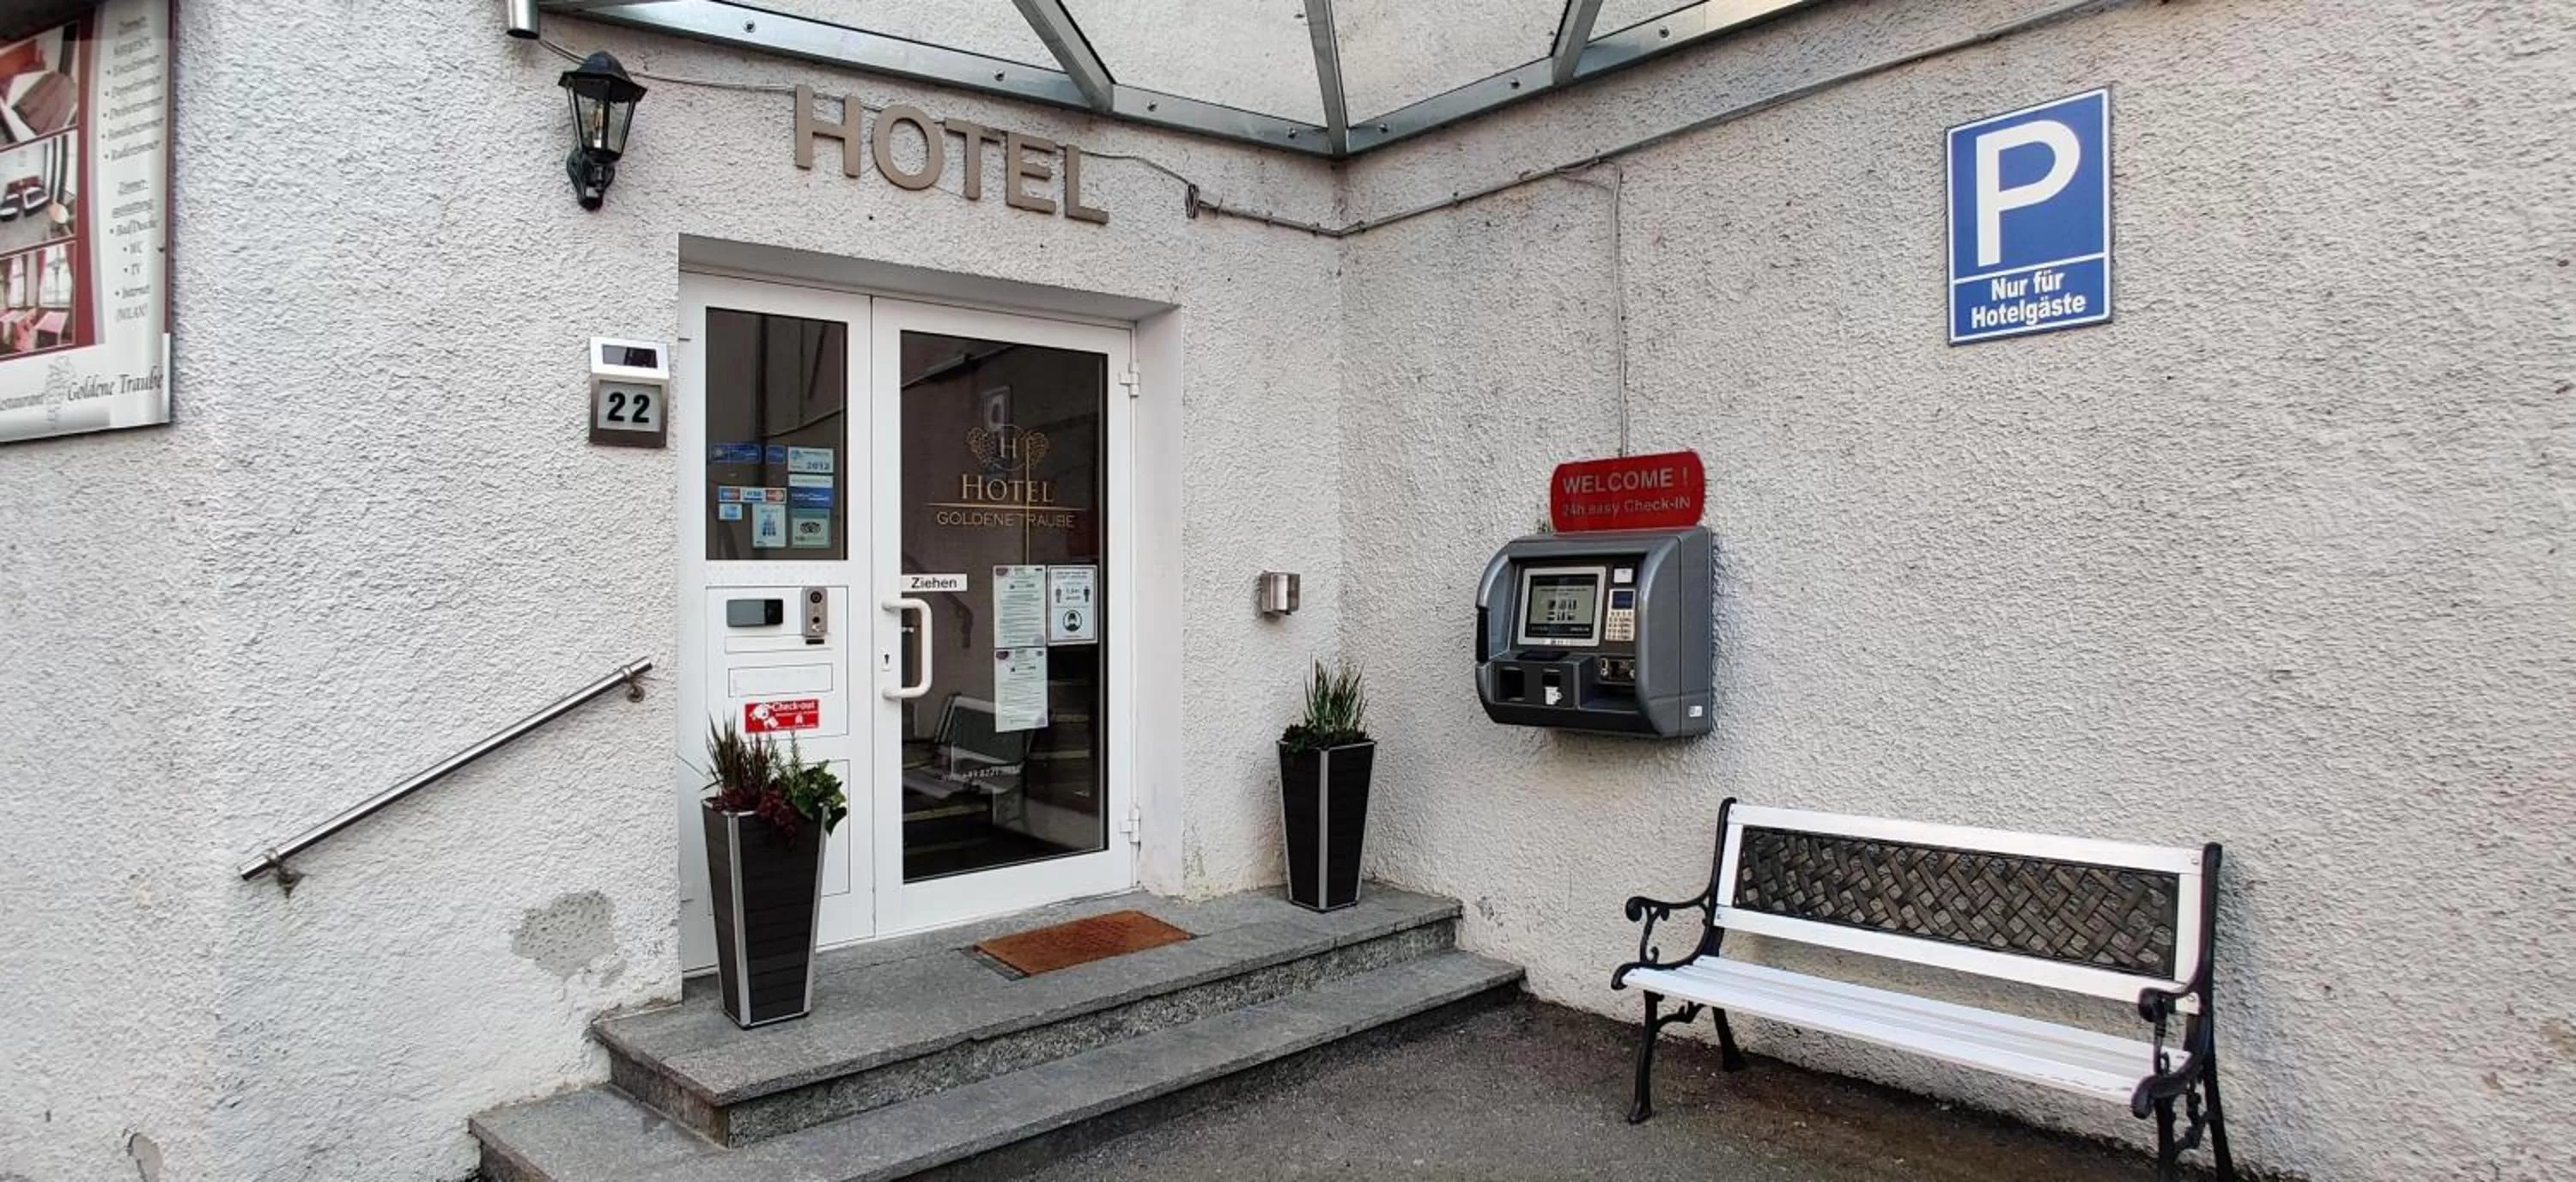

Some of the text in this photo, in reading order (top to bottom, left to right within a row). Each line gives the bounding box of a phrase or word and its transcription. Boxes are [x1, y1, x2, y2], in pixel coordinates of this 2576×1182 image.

[794, 84, 1110, 225] HOTEL
[1976, 119, 2081, 268] P
[1990, 268, 2066, 302] Nur für
[1971, 291, 2087, 329] Hotelgäste
[607, 391, 650, 423] 22
[999, 436, 1018, 460] H
[960, 472, 1054, 503] HOTEL
[1562, 466, 1690, 496] WELCOME !
[936, 510, 1077, 529] GOLDENE TRAUBE
[1624, 494, 1692, 514] Check-IN
[910, 576, 958, 590] Ziehen
